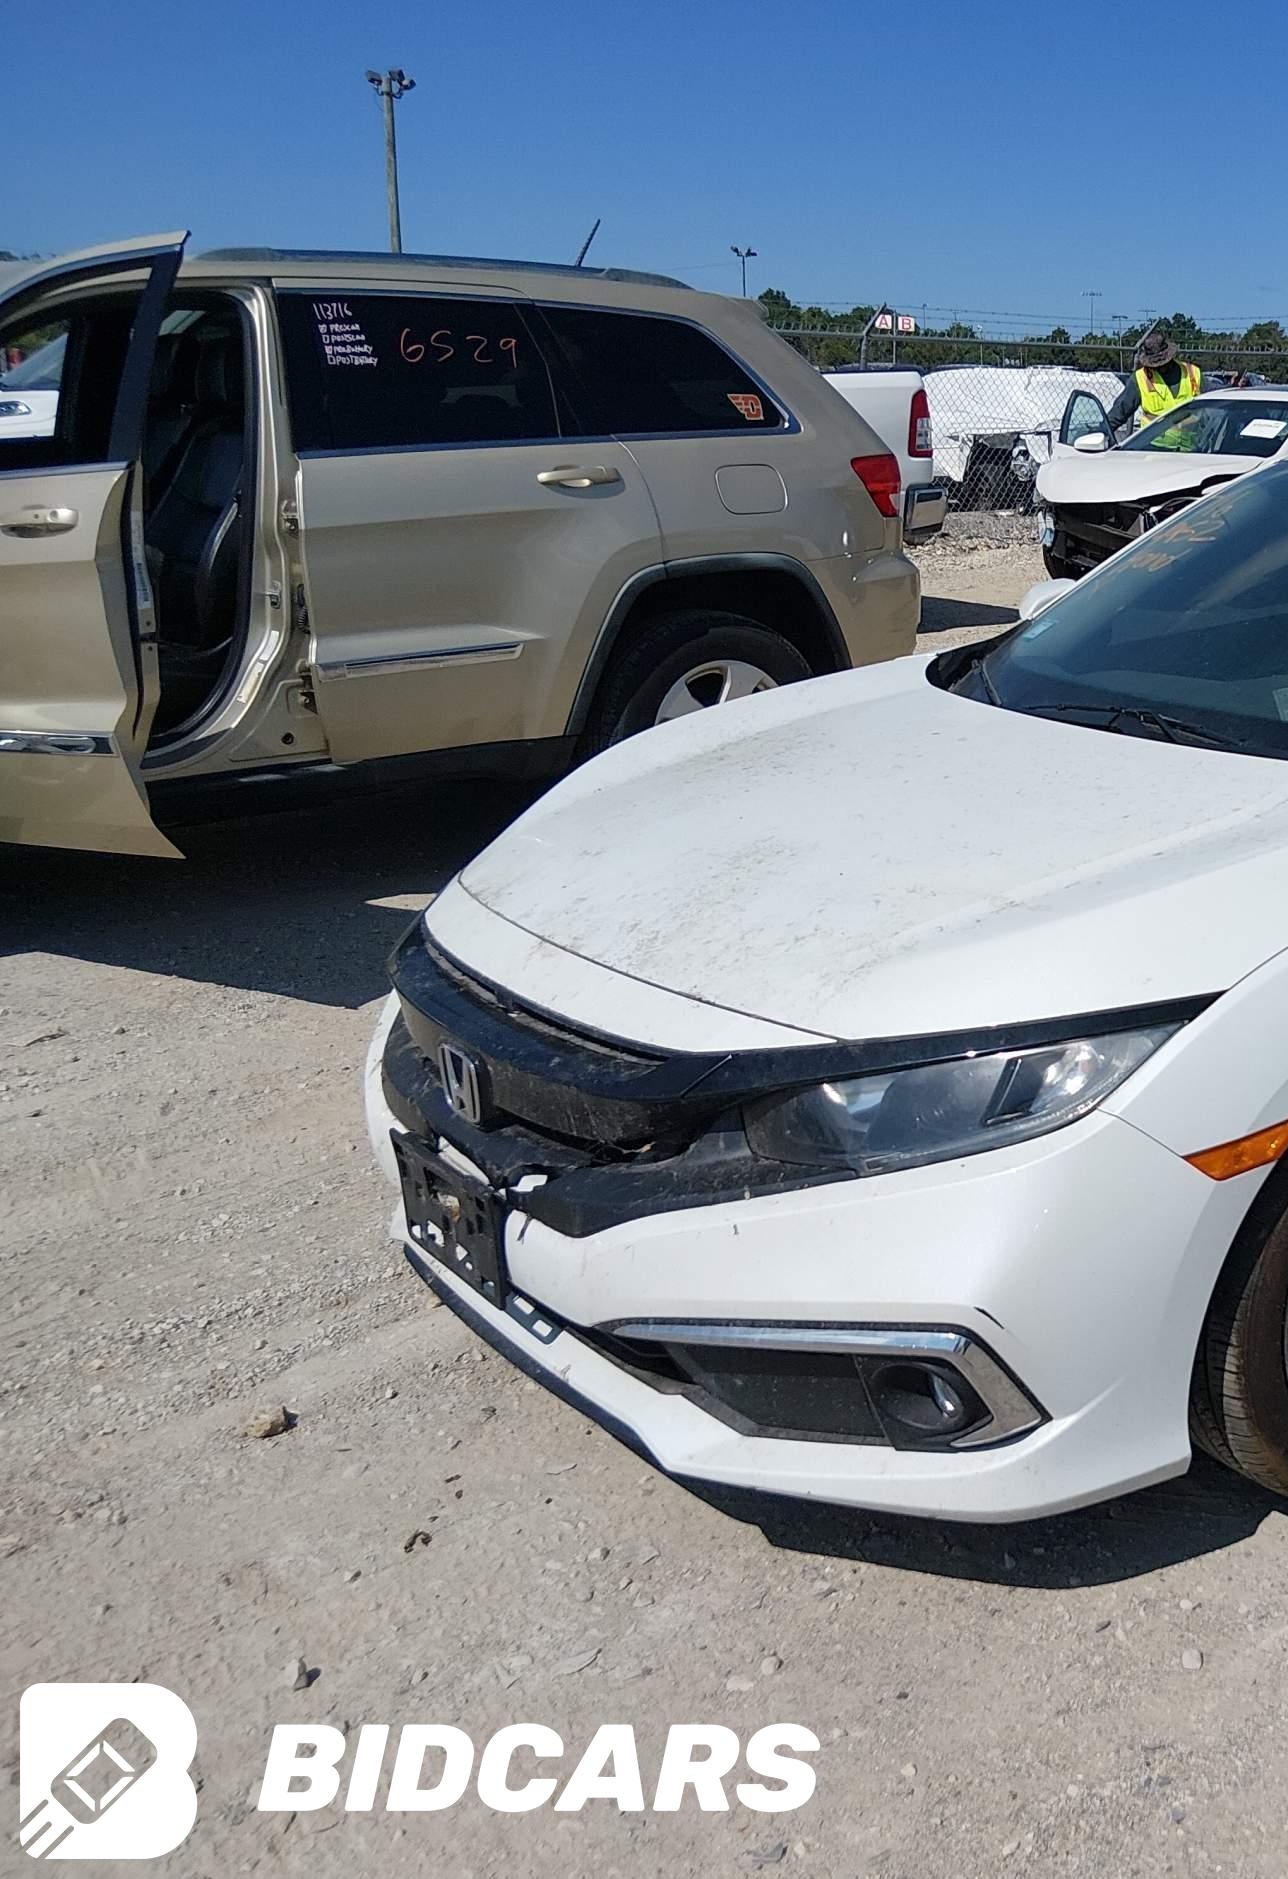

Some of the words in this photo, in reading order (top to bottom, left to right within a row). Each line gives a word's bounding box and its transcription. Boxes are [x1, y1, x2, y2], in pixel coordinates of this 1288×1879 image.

[879, 314, 889, 328] A
[902, 318, 912, 330] B
[400, 327, 518, 369] 6529
